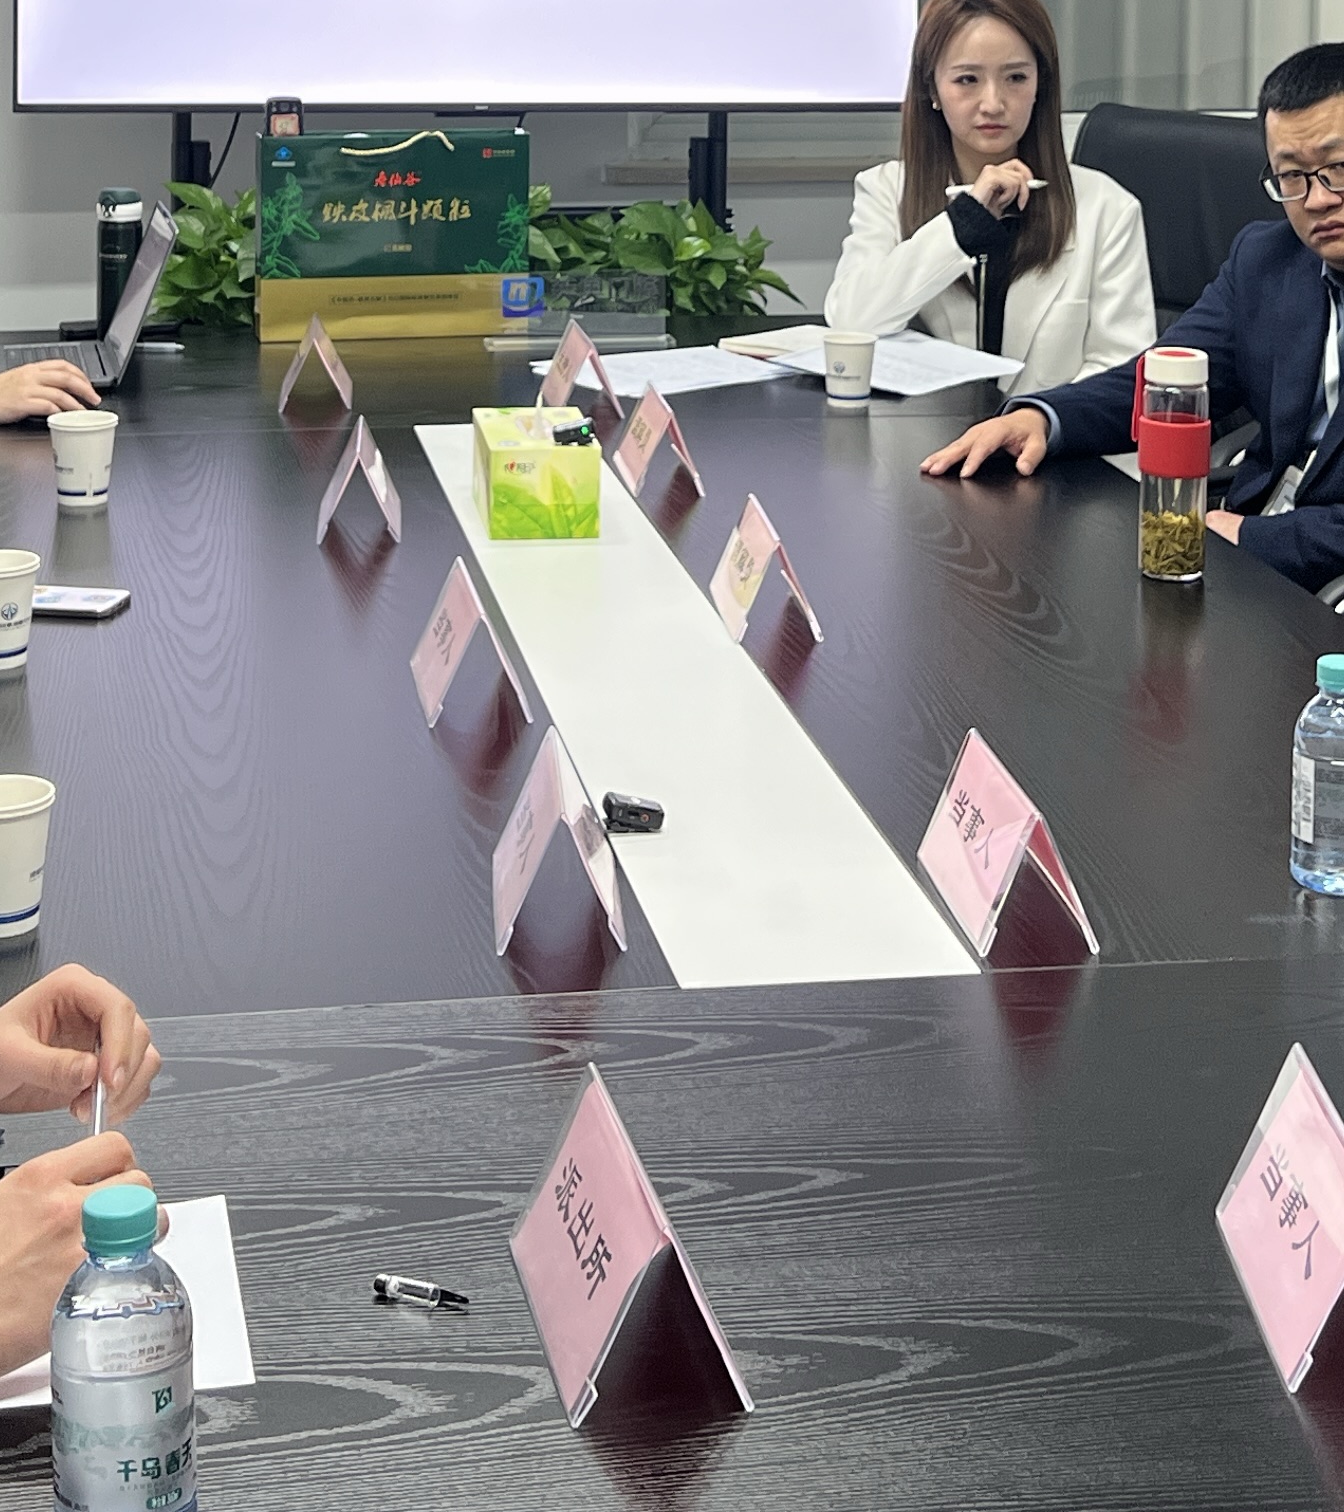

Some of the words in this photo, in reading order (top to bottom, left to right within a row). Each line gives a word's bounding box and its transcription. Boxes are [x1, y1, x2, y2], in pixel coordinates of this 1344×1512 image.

[948, 789, 994, 870] 当事人
[554, 1157, 613, 1301] 派出所
[1259, 1142, 1320, 1281] 当事人
